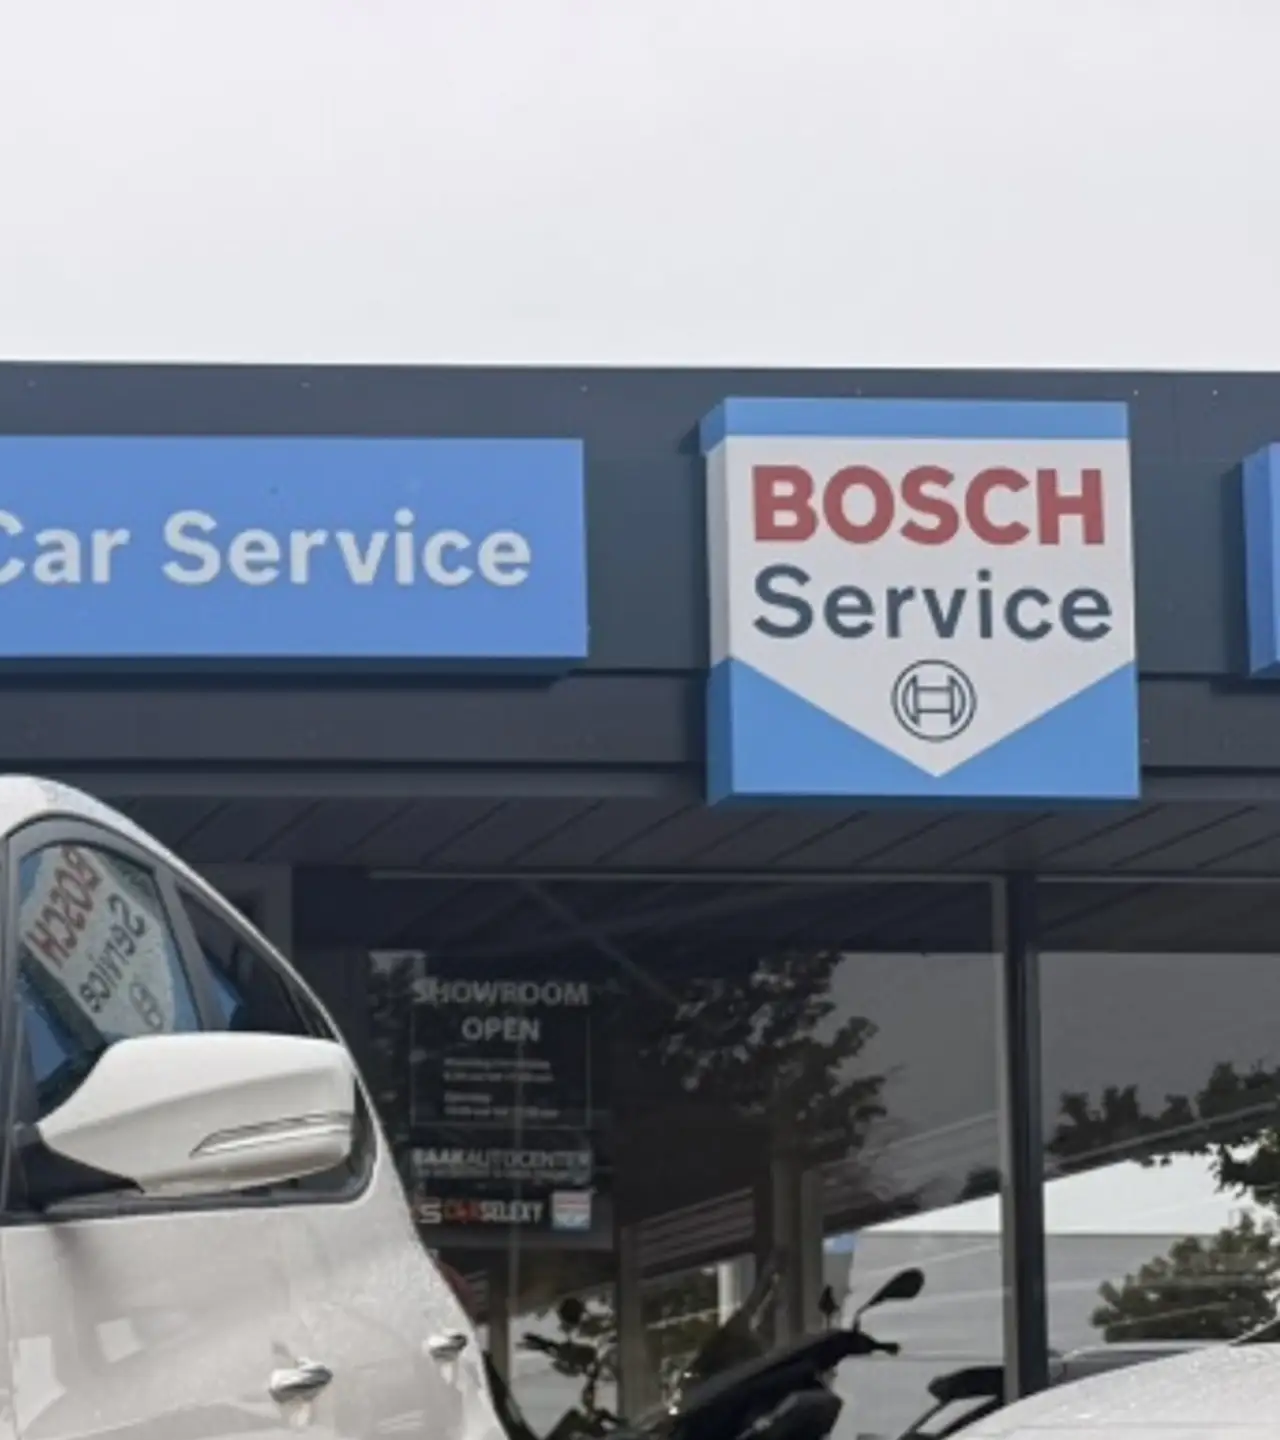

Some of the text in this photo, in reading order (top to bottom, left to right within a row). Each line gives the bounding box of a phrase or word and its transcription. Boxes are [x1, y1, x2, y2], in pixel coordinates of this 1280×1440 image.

[752, 464, 1105, 545] BOSCH
[160, 508, 532, 588] Service
[753, 563, 1113, 641] Service
[411, 977, 590, 1006] SHOWROOM
[460, 1015, 541, 1042] OPEN
